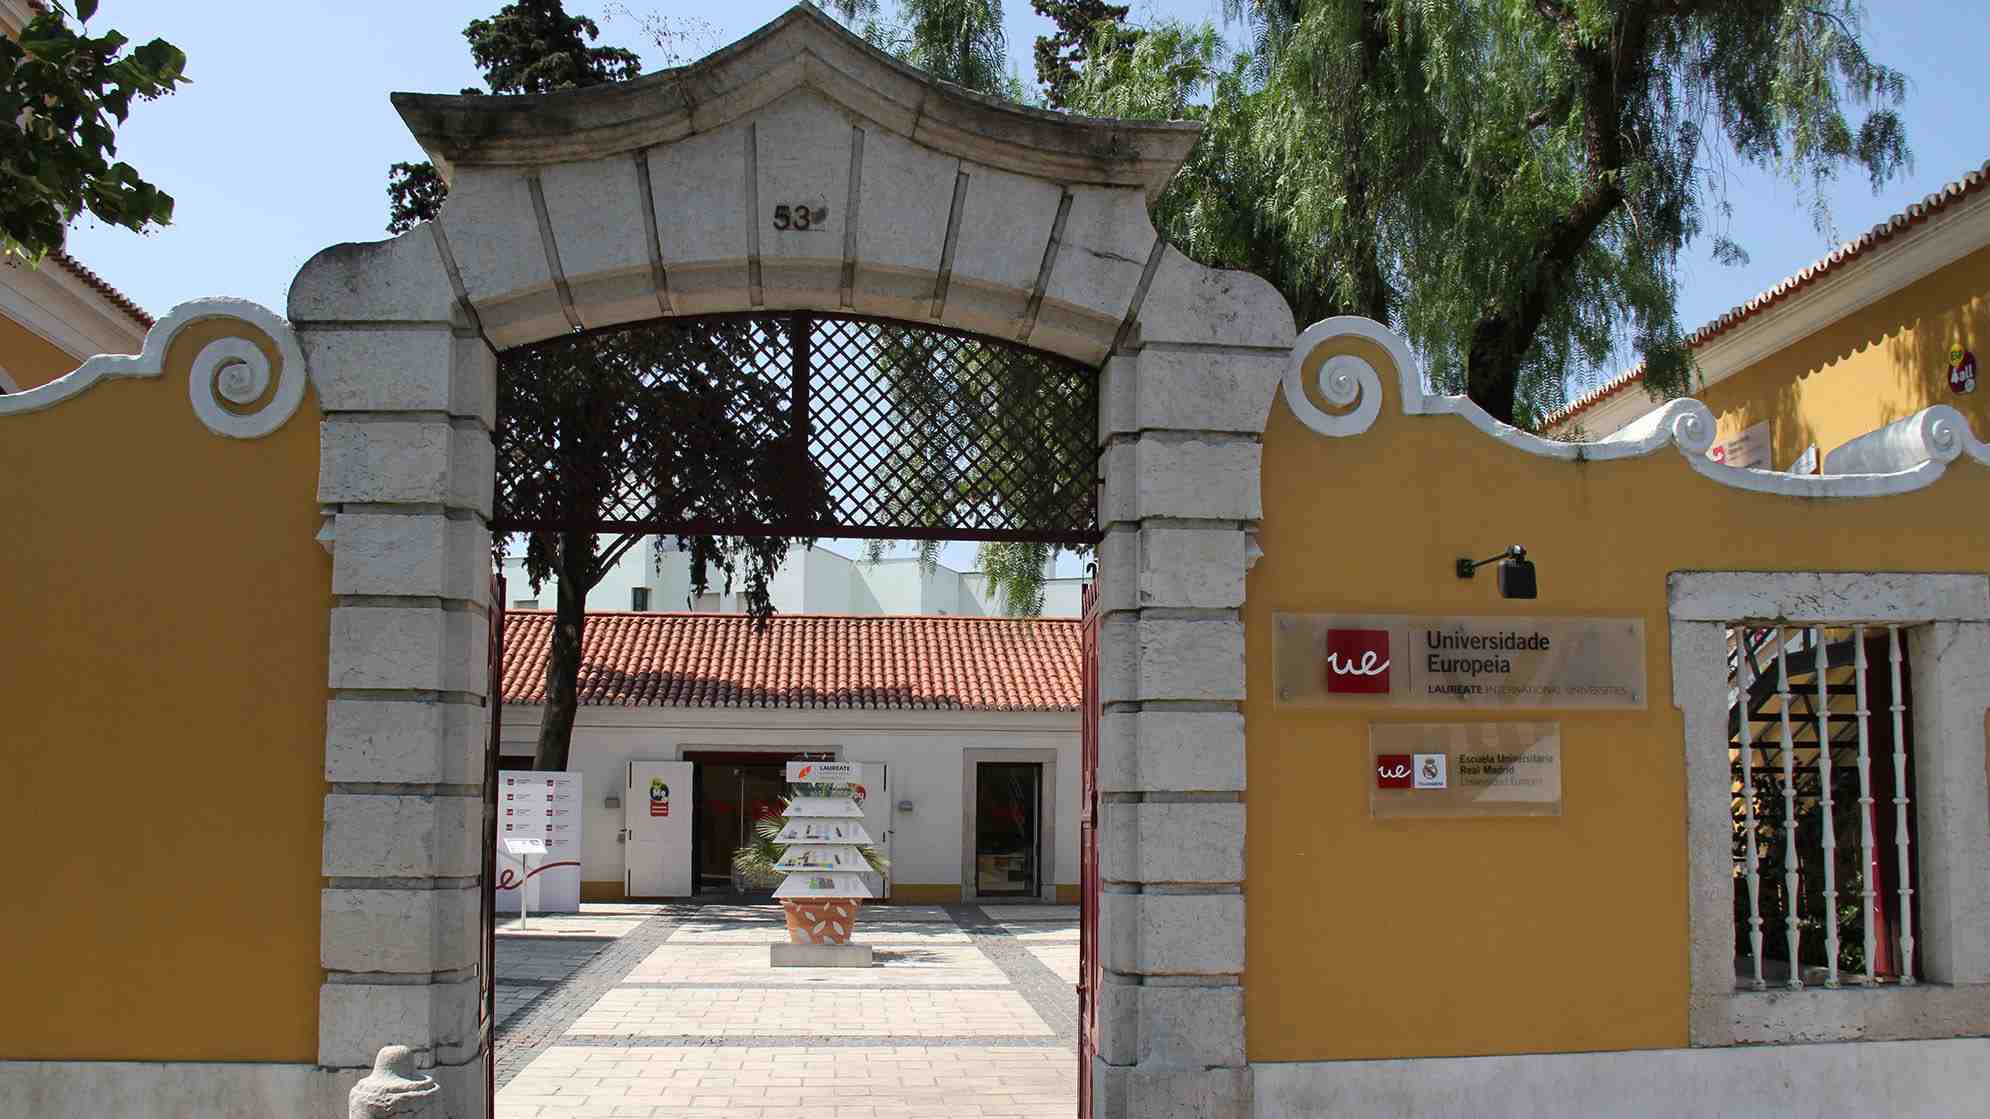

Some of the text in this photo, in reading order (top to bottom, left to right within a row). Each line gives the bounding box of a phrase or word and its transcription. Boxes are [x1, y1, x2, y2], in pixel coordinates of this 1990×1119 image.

[773, 205, 810, 231] 53
[1427, 630, 1551, 650] Universidade
[1327, 650, 1391, 676] ue
[1427, 654, 1512, 677] Europeia
[1427, 684, 1483, 695] LAUREATE
[1378, 764, 1412, 779] ue
[1459, 765, 1481, 775] Real
